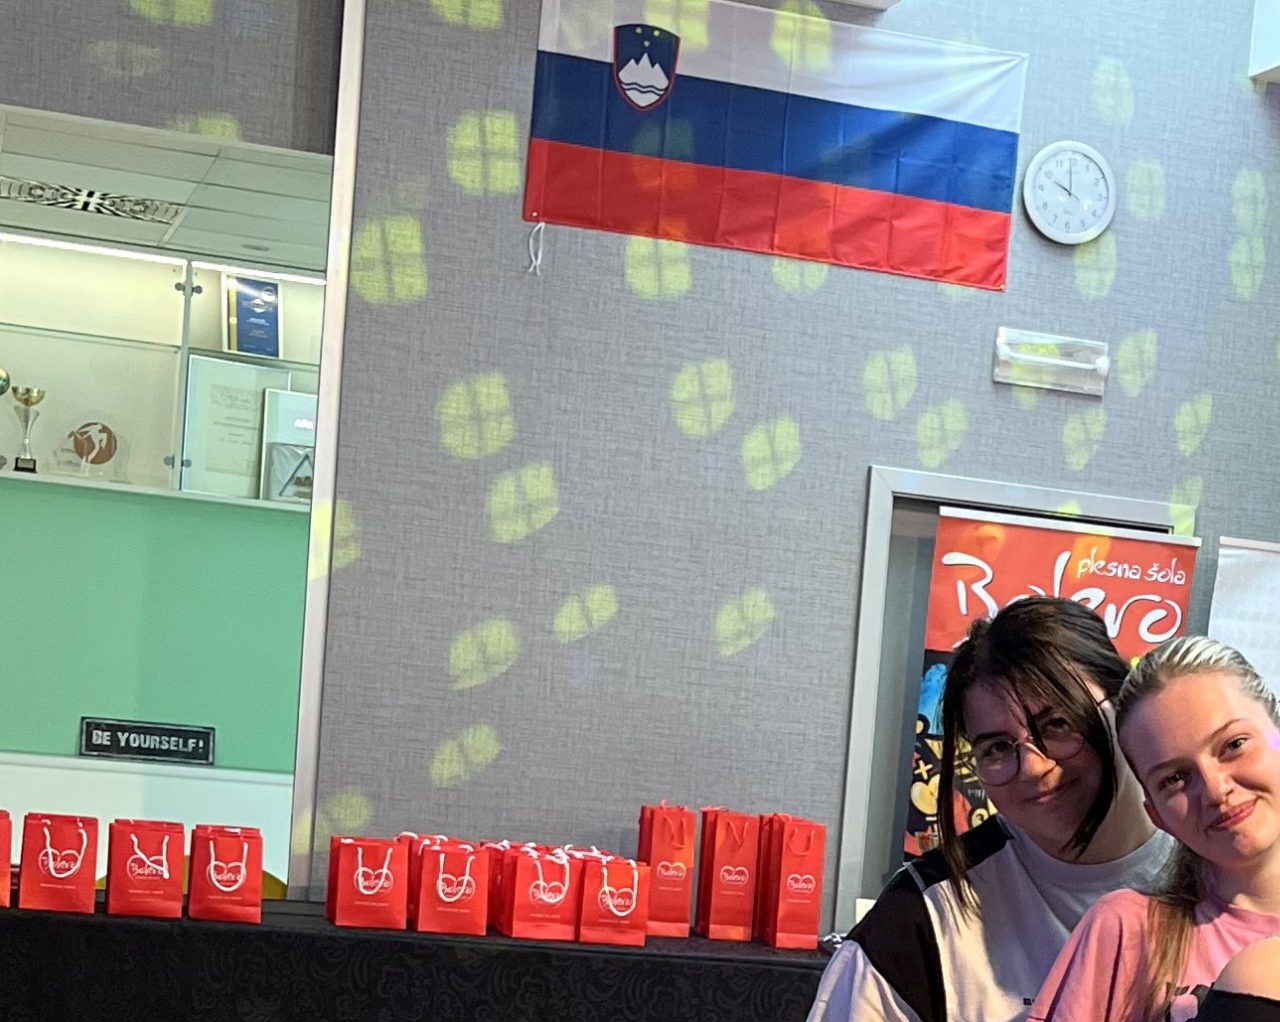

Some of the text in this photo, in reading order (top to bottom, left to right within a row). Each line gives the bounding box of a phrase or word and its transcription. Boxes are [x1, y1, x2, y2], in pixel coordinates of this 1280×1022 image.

[1076, 547, 1186, 585] plesna šola
[91, 729, 111, 746] BE
